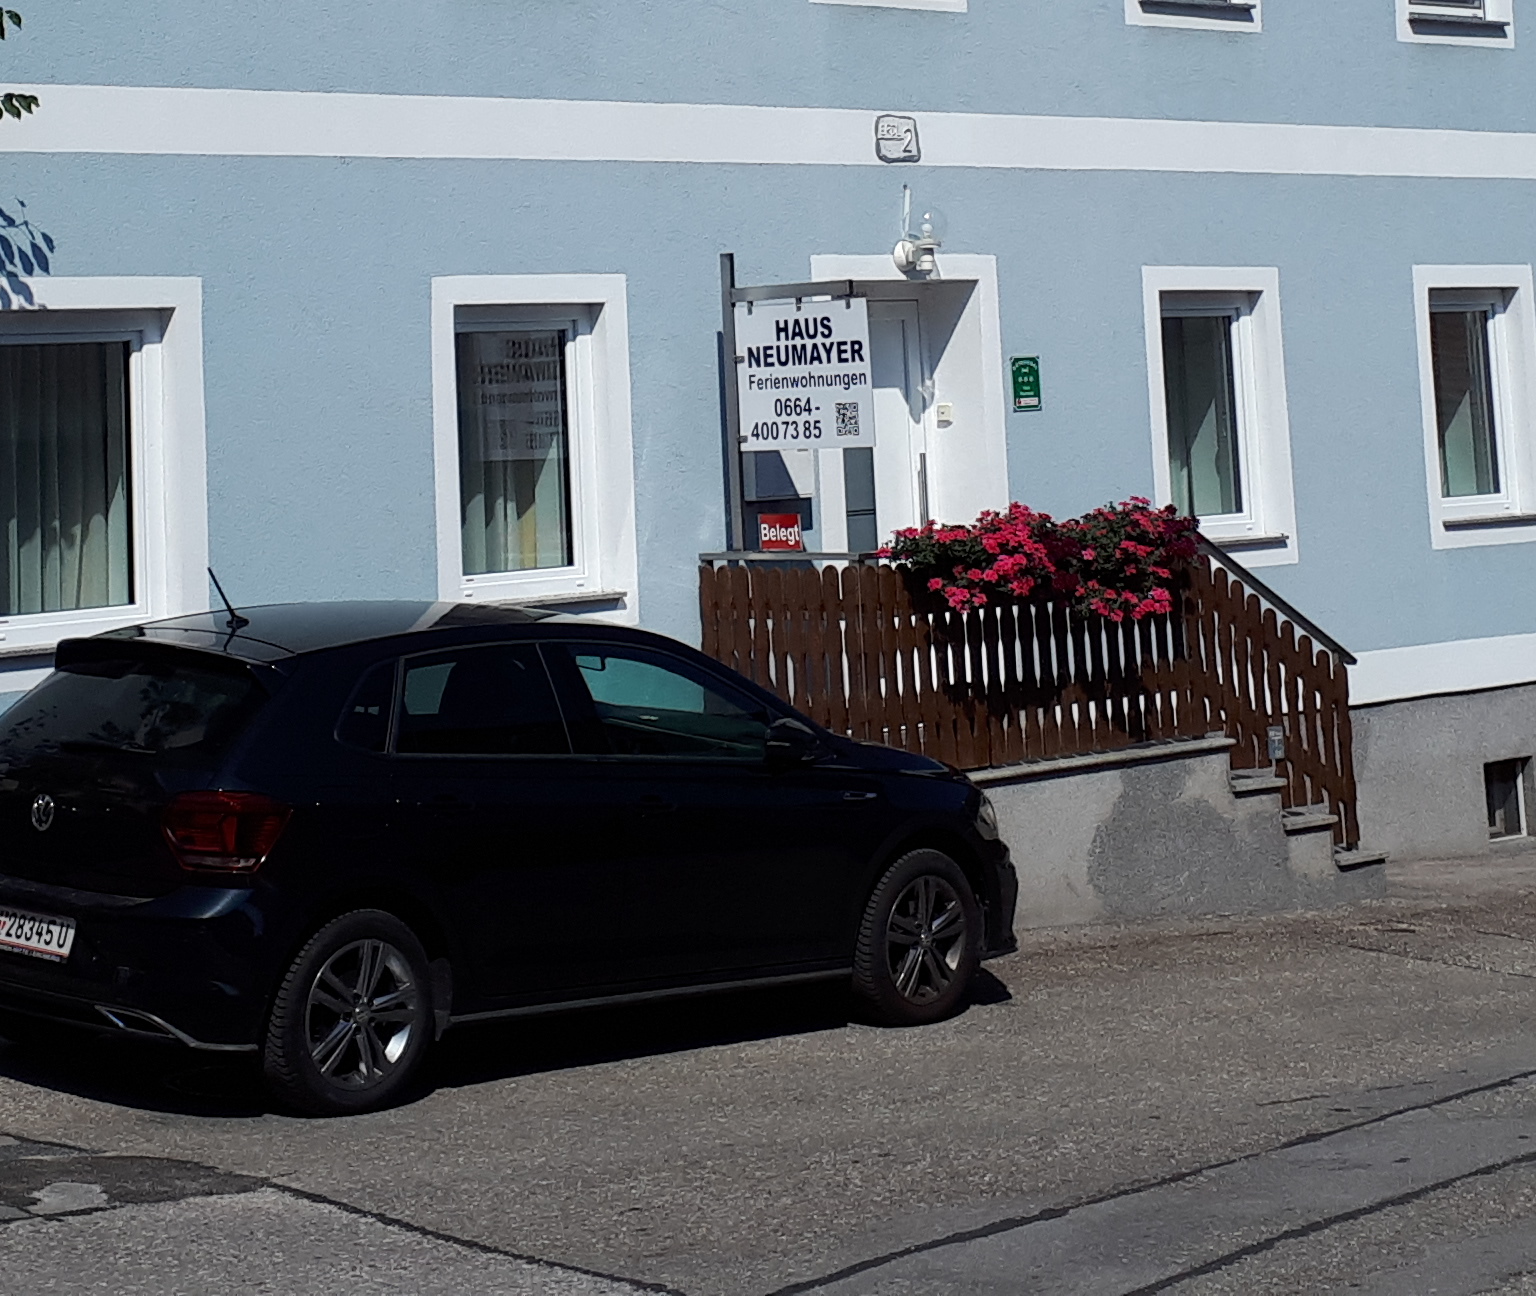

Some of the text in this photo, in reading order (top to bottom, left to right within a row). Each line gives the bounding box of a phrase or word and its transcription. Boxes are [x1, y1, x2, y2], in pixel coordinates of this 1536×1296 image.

[902, 128, 912, 153] 2
[775, 316, 832, 341] HAUS
[747, 340, 864, 368] NEUMAYER
[748, 371, 867, 390] Ferienwohnungen
[774, 397, 820, 417] 0664-
[760, 523, 799, 545] Belegt
